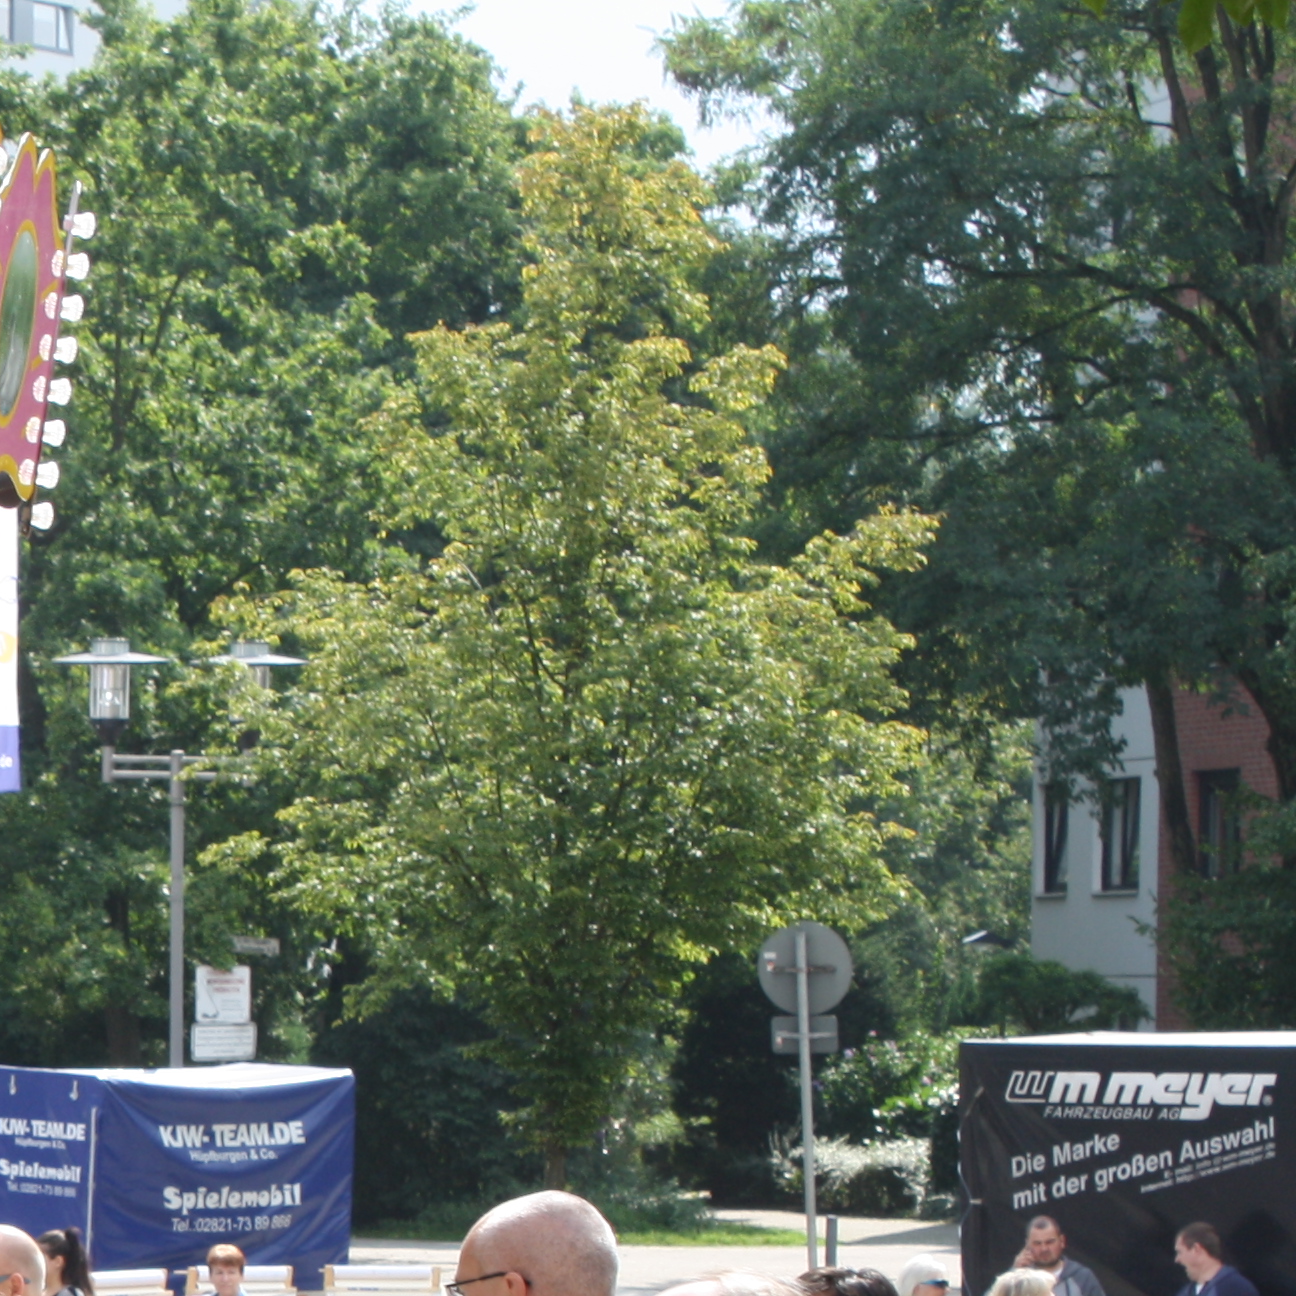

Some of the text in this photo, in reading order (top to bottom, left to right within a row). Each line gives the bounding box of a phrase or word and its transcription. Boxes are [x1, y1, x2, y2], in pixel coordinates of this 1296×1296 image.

[1043, 1105, 1181, 1121] FAHRZEUGBAU AG
[30, 1119, 86, 1141] TEAM.DE
[158, 1120, 307, 1149] KJW- TEAM.DE
[188, 1148, 279, 1164] Hüpfburgen & Co.
[1011, 1132, 1121, 1179] Die Marke
[1012, 1116, 1276, 1210] mit der großen Auswahl
[162, 1182, 303, 1216] Spielemobil
